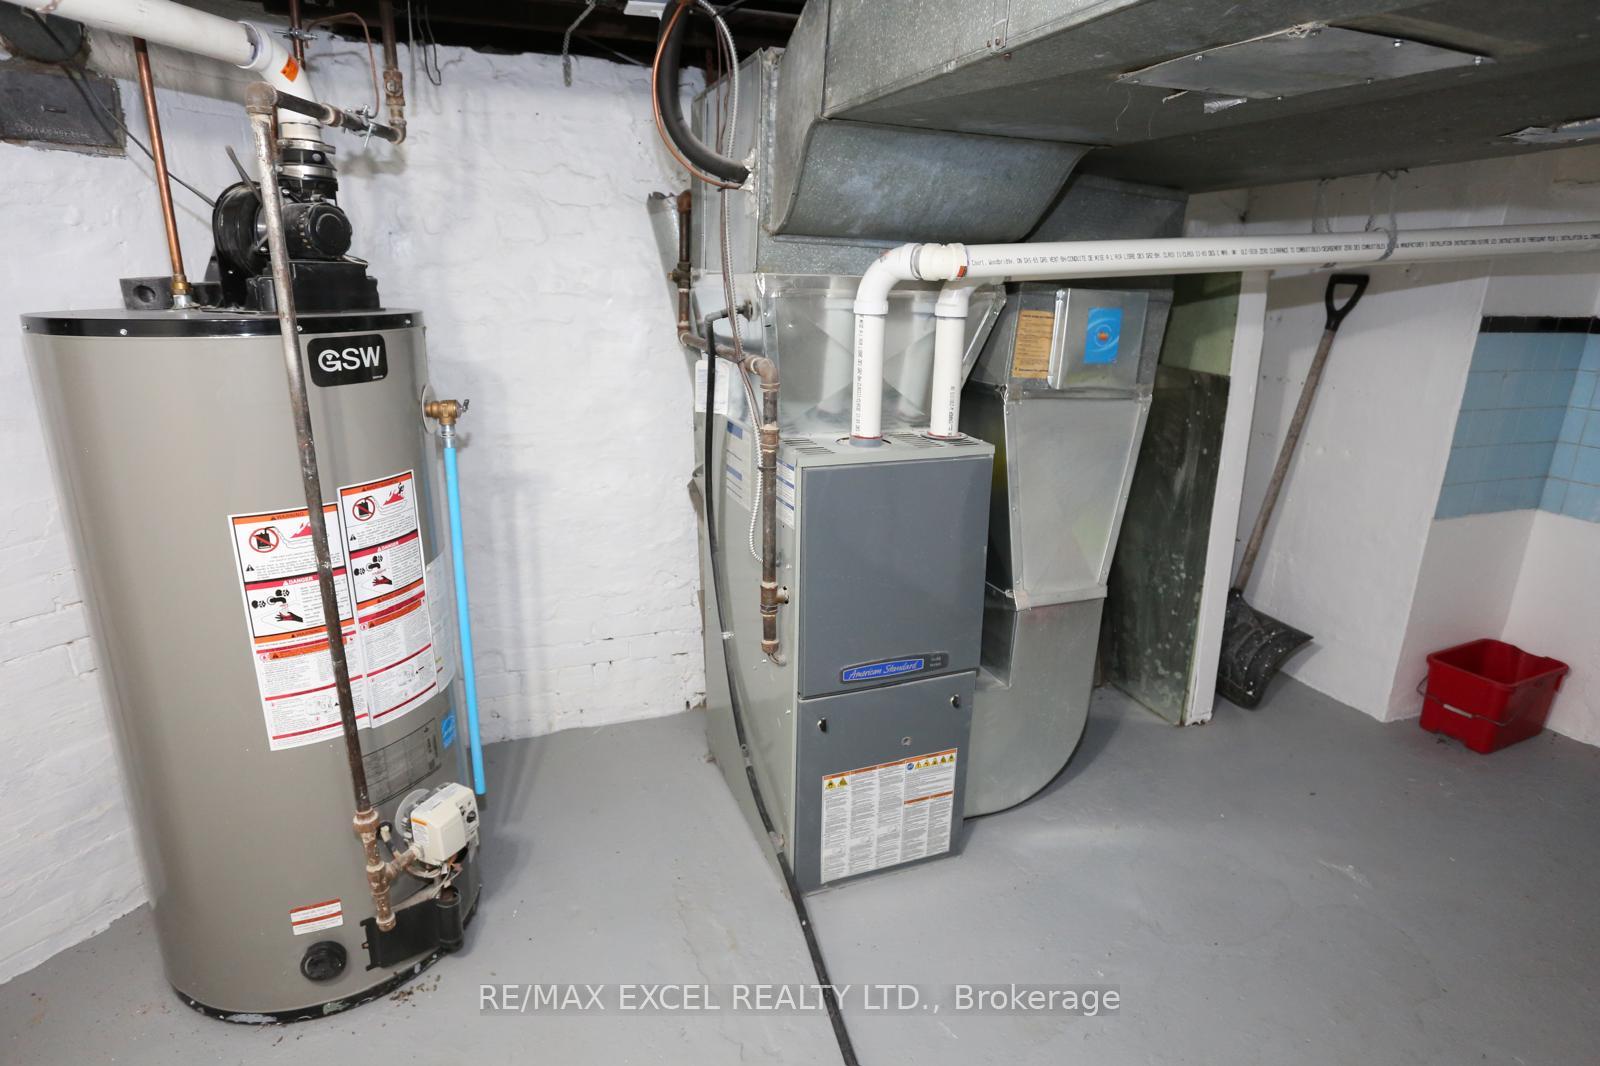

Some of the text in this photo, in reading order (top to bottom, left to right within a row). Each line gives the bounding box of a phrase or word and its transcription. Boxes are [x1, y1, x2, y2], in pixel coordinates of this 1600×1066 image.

[318, 346, 380, 372] GSW
[288, 577, 314, 585] DANGER
[848, 668, 882, 680] American
[884, 660, 918, 674] Standard
